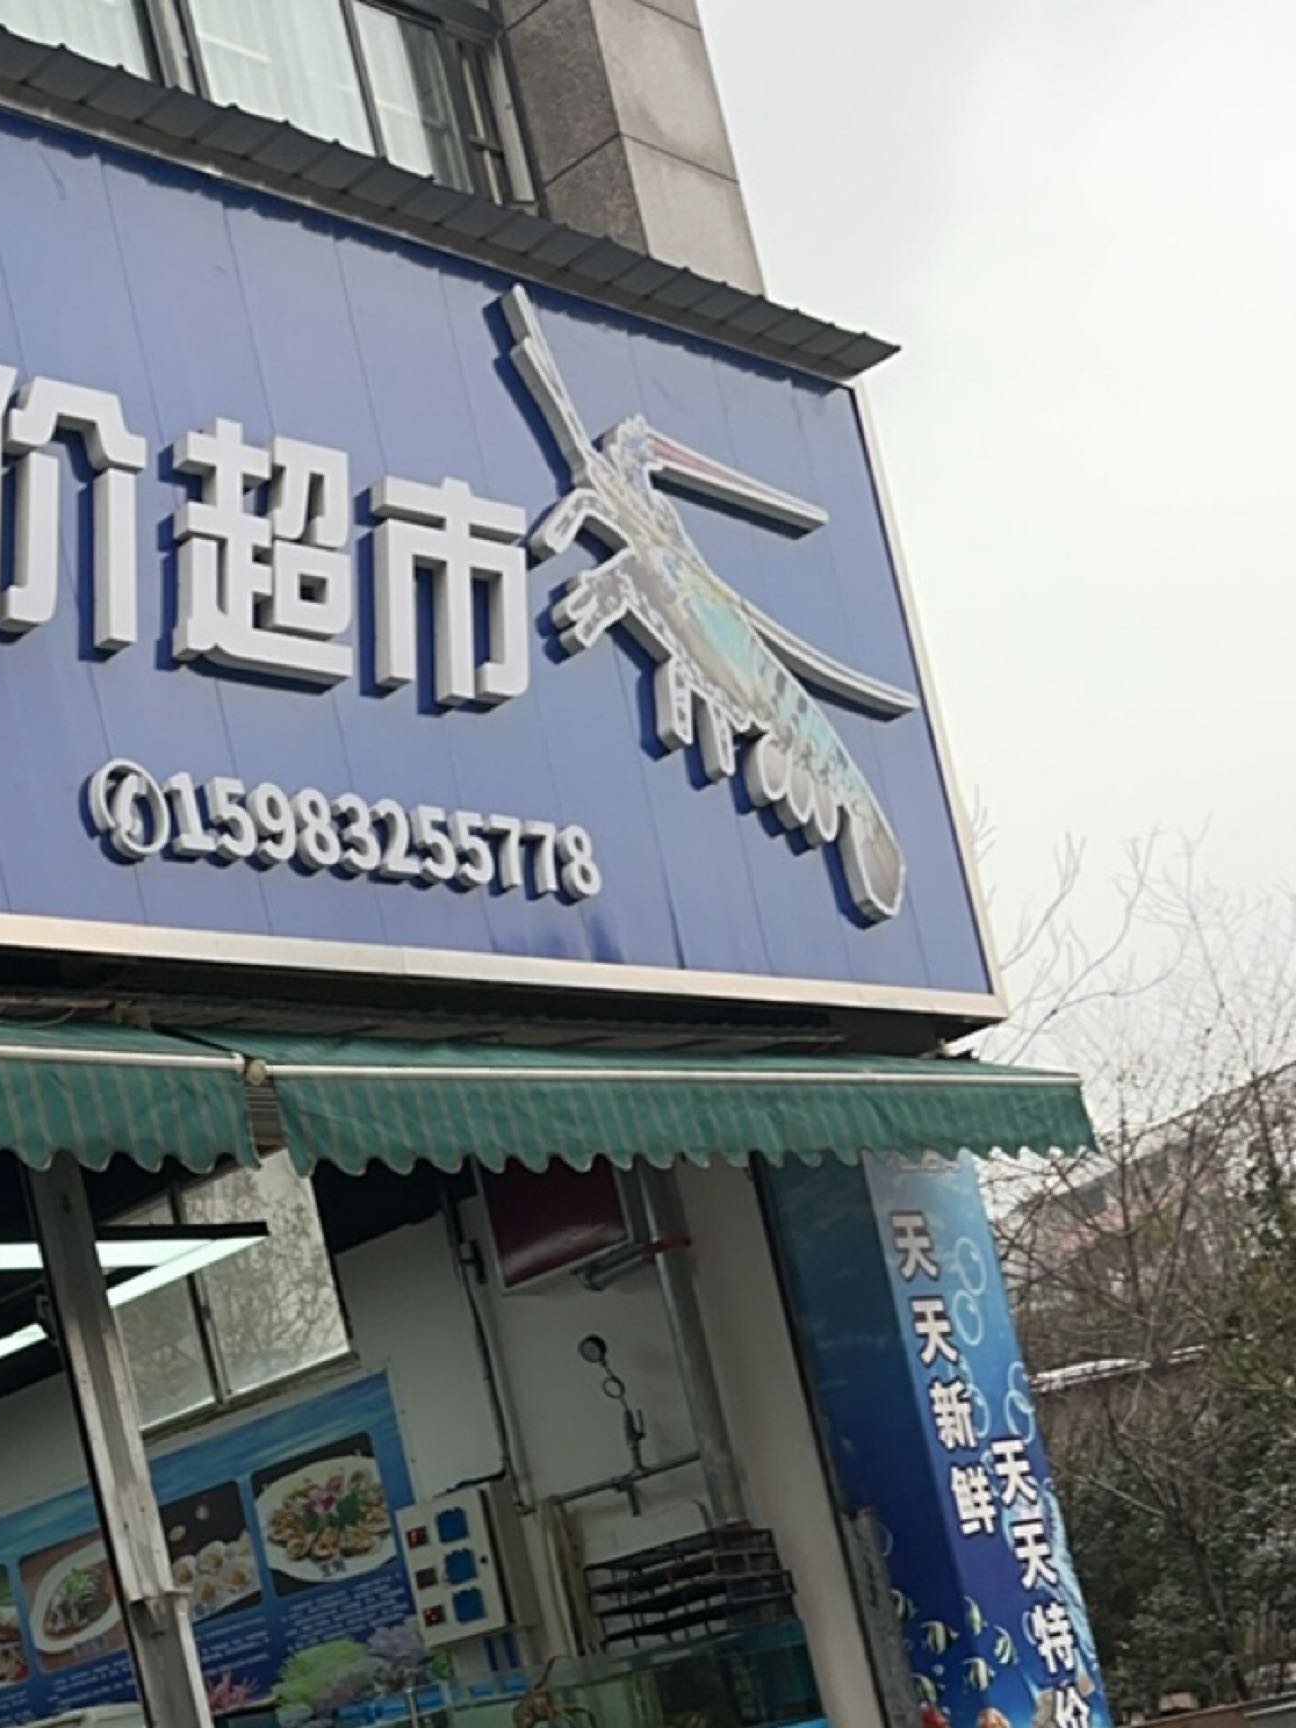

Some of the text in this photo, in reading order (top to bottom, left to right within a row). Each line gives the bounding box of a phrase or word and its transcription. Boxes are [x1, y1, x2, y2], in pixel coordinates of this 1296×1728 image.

[164, 770, 602, 900] 15983255778
[892, 1212, 997, 1536] 天天新鲜
